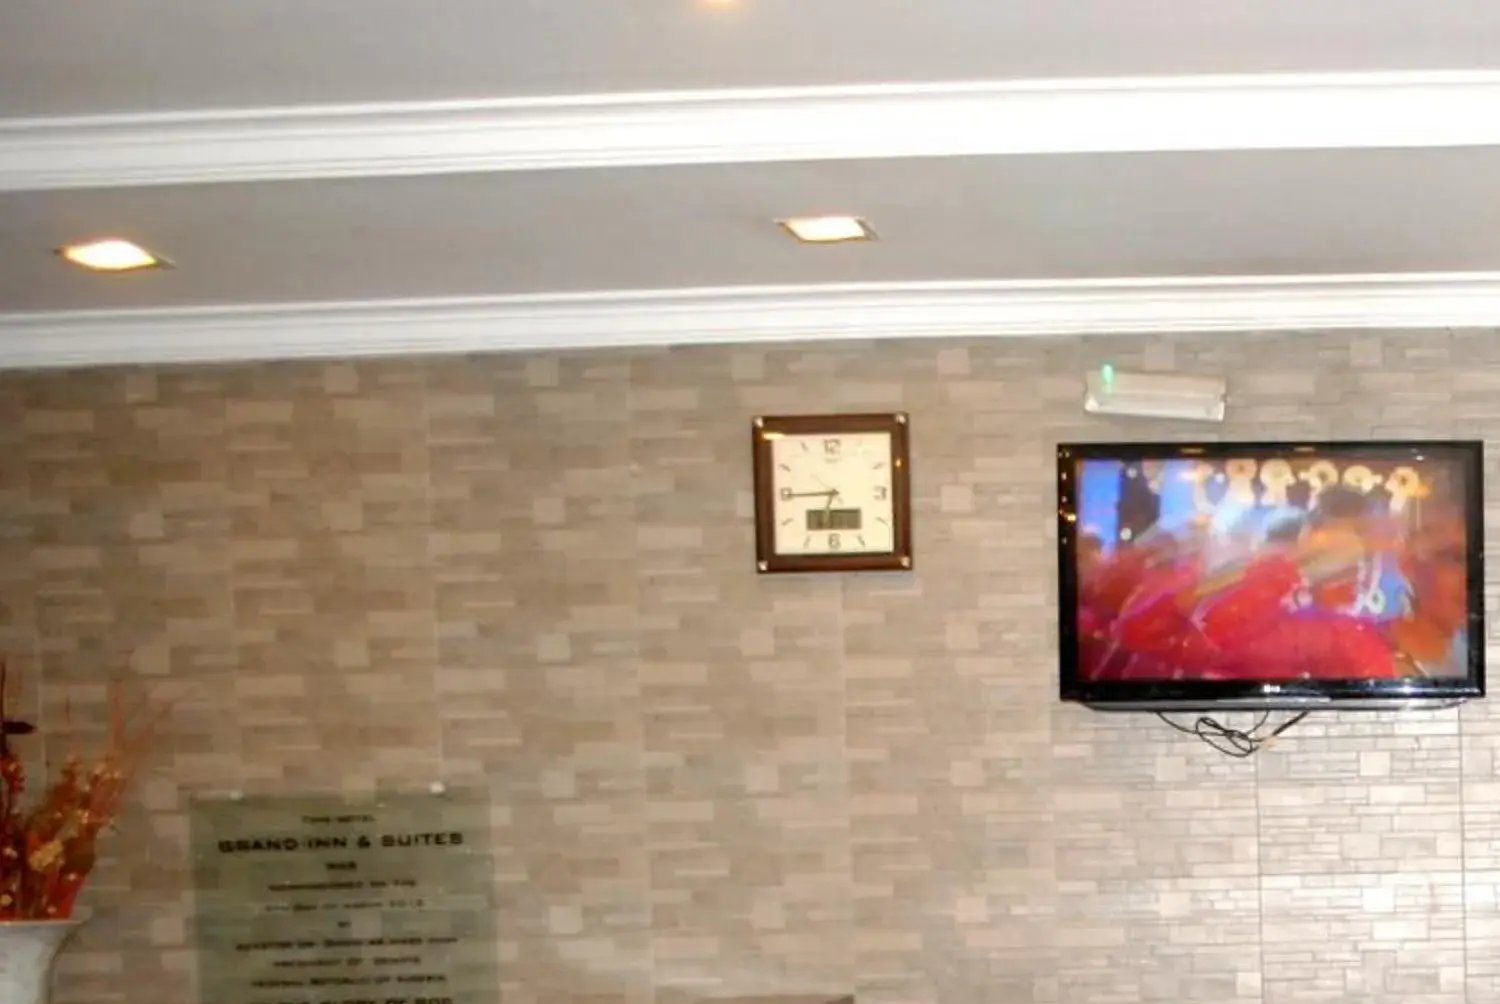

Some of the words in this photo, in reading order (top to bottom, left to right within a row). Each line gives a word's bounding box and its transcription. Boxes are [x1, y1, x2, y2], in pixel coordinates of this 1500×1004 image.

[218, 838, 299, 853] GRAND
[357, 834, 371, 849] &
[381, 832, 464, 848] SUITES
